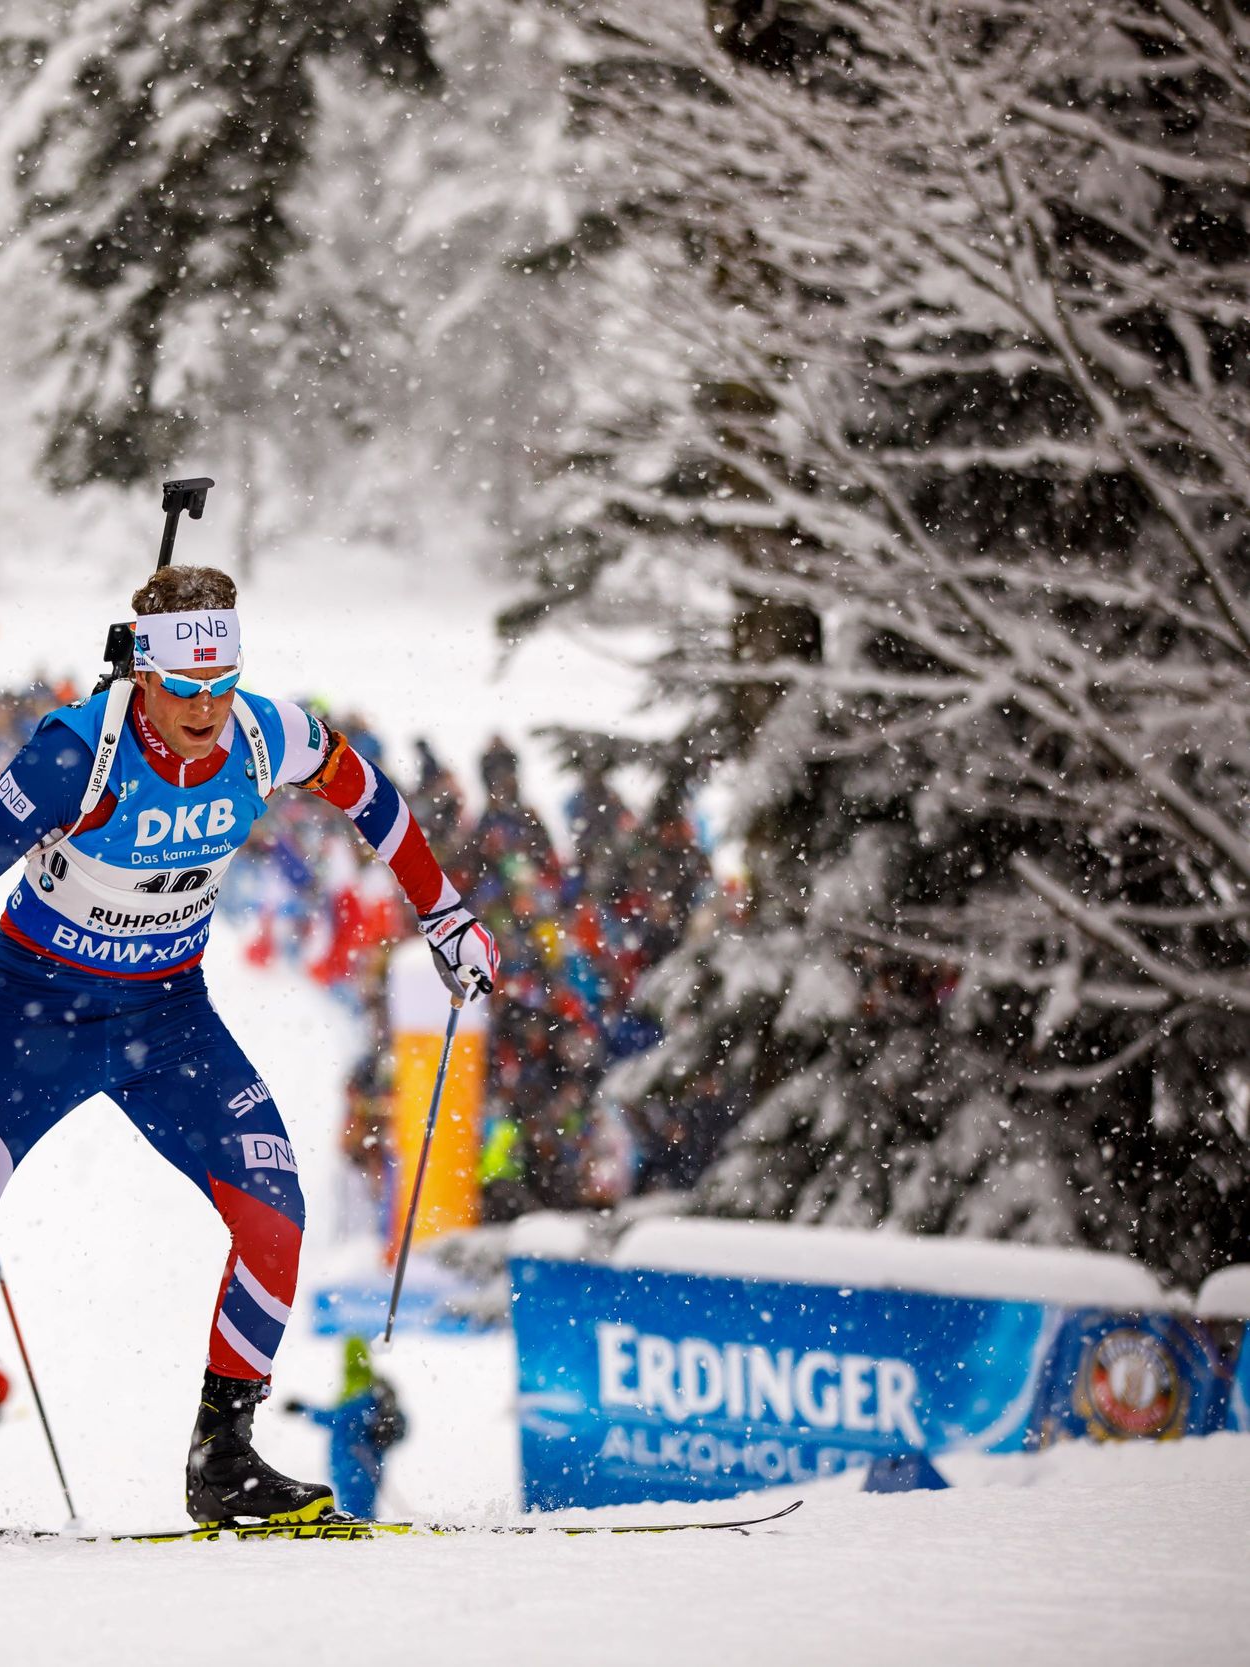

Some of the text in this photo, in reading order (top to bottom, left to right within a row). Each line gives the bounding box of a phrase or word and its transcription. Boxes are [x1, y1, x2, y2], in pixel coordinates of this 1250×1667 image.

[176, 616, 228, 645] DNB
[91, 746, 112, 793] Statkraft
[255, 739, 269, 781] Statkraft
[0, 777, 27, 814] DNB
[134, 798, 237, 847] DKB
[131, 852, 159, 864] Das
[201, 839, 233, 855] Bank
[89, 887, 219, 928] RUHPOLDING
[51, 924, 148, 964] BMW
[596, 1320, 926, 1448] ERDINGER
